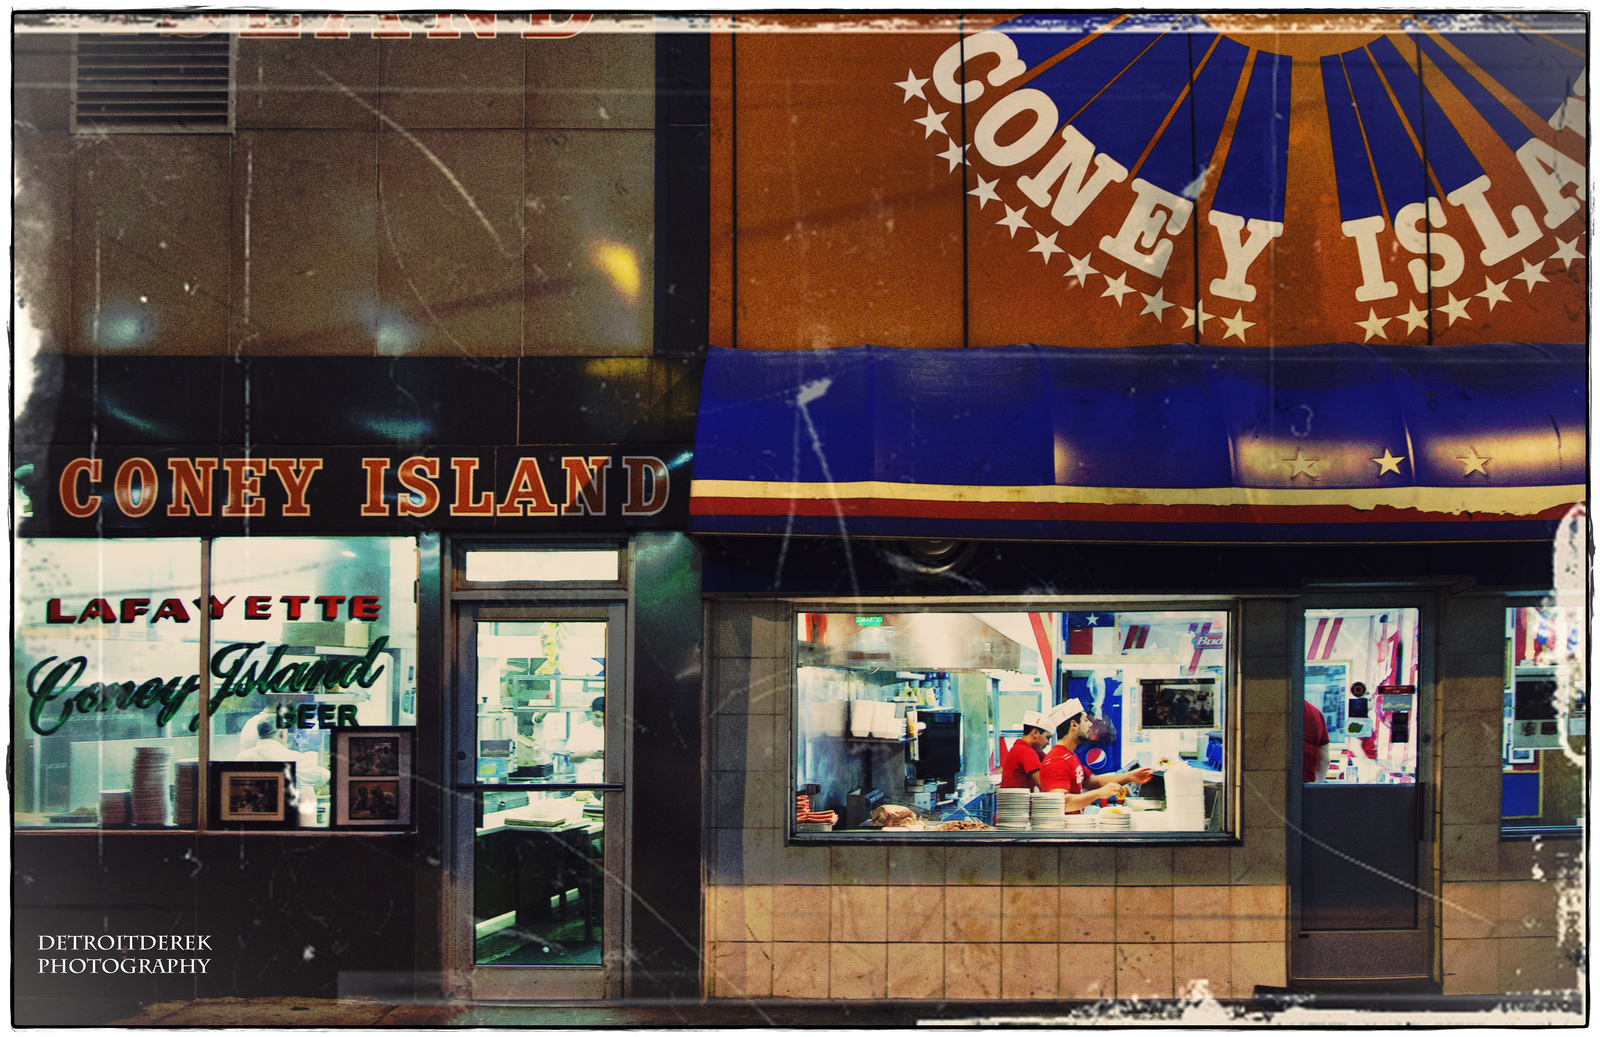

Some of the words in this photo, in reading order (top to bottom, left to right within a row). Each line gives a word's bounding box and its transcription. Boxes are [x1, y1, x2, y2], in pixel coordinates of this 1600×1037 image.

[932, 31, 1284, 302] CONEY
[59, 457, 323, 518] CONEY
[361, 456, 670, 518] ISLAND
[46, 596, 382, 624] LAFAYETTE
[27, 656, 201, 736] Coney
[189, 635, 390, 732] Island
[276, 703, 359, 729] BEER
